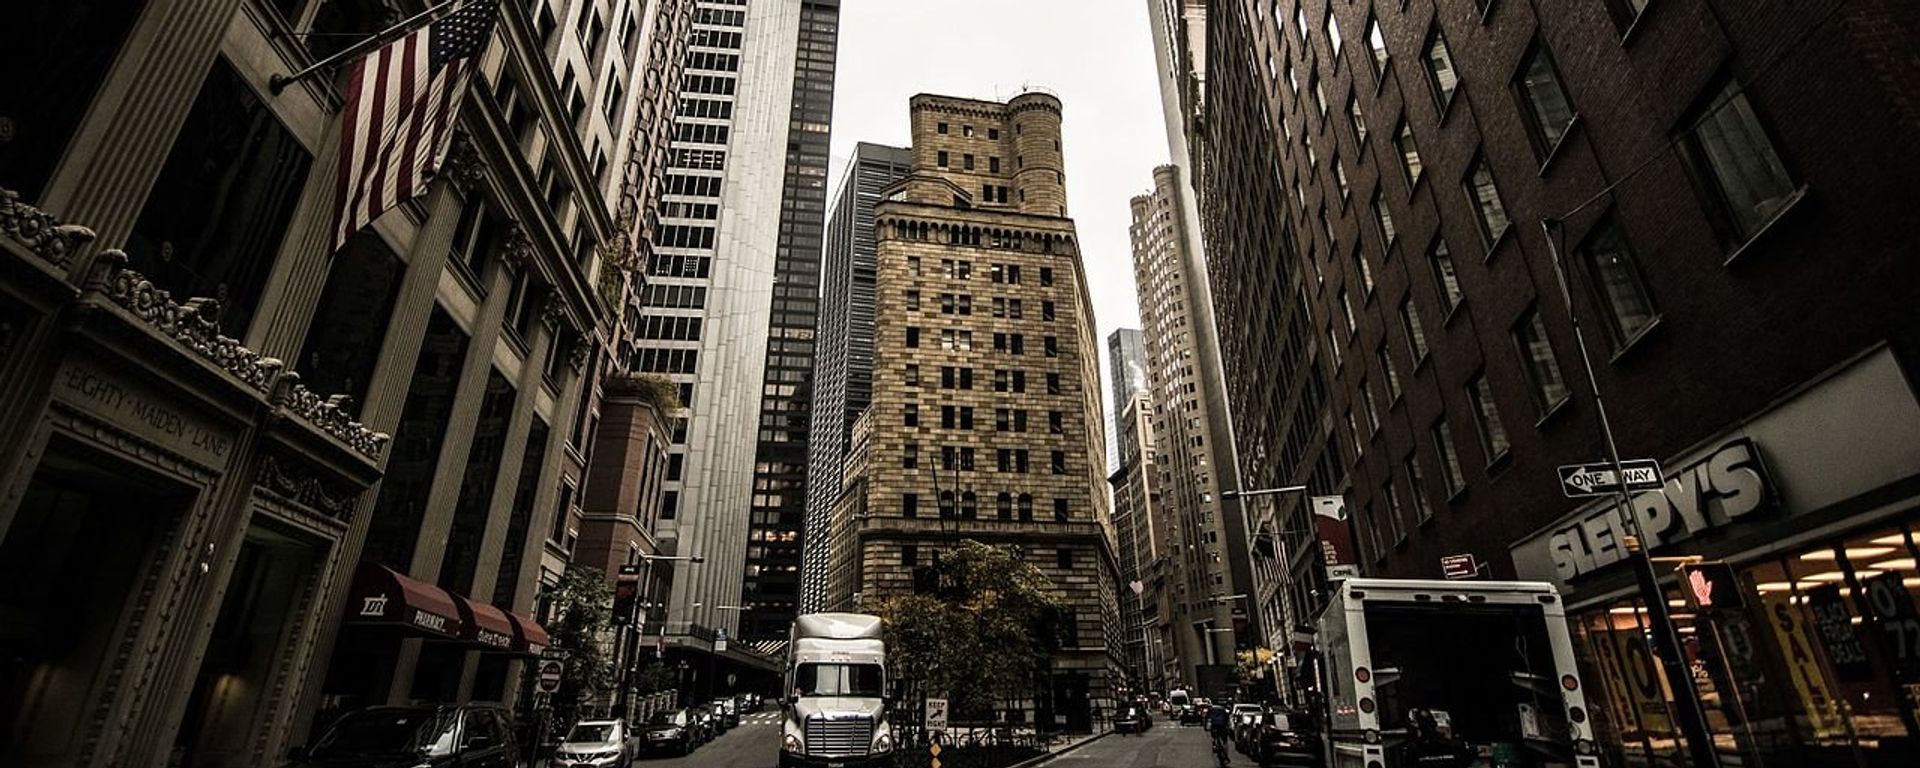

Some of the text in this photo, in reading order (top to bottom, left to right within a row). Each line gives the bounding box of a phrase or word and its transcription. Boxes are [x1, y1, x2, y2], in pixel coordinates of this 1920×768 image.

[68, 367, 228, 456] EIGHTY MAIDEN LANE
[1572, 467, 1651, 487] ONE WAY
